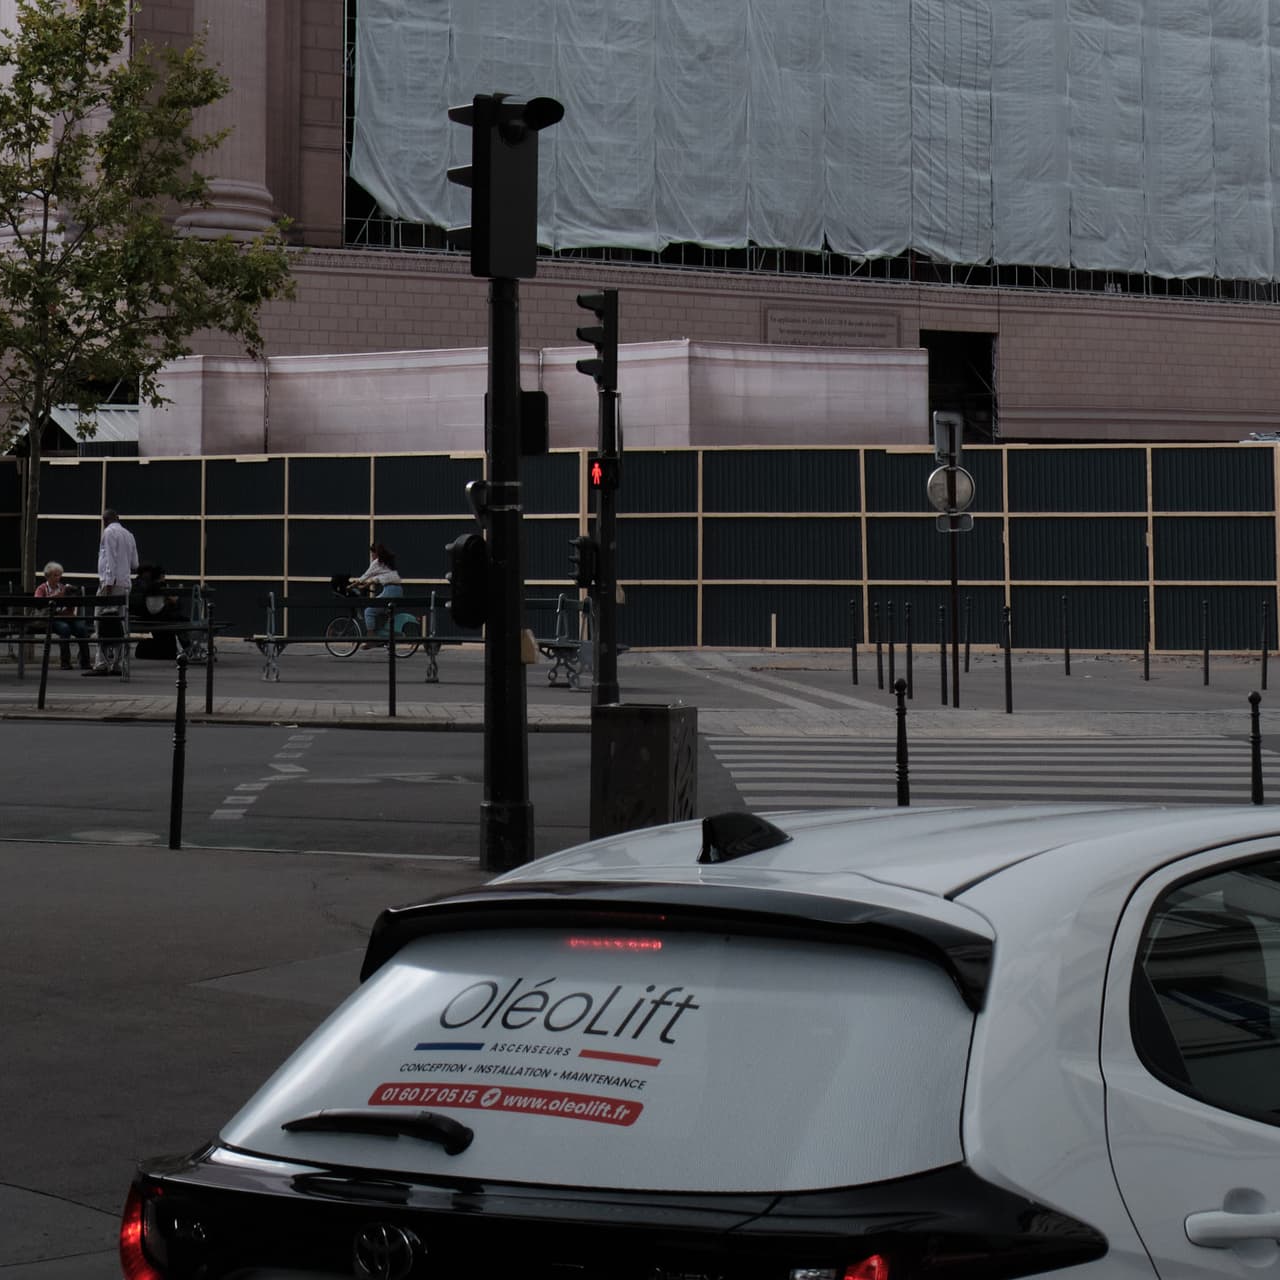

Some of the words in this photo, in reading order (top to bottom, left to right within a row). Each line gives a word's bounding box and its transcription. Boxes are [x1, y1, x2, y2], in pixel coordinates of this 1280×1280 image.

[489, 1042, 572, 1057] ASCENSEURS
[399, 1062, 468, 1073] CONCEPTION
[473, 1064, 552, 1080] INSTALLATION
[559, 1070, 648, 1091] MAINTENANCE
[381, 1087, 397, 1101] 01
[398, 1087, 417, 1101] 60
[419, 1087, 437, 1102] 17
[439, 1088, 458, 1102] 05
[459, 1089, 477, 1104] 15
[502, 1093, 631, 1121] www.oleolift.fr
